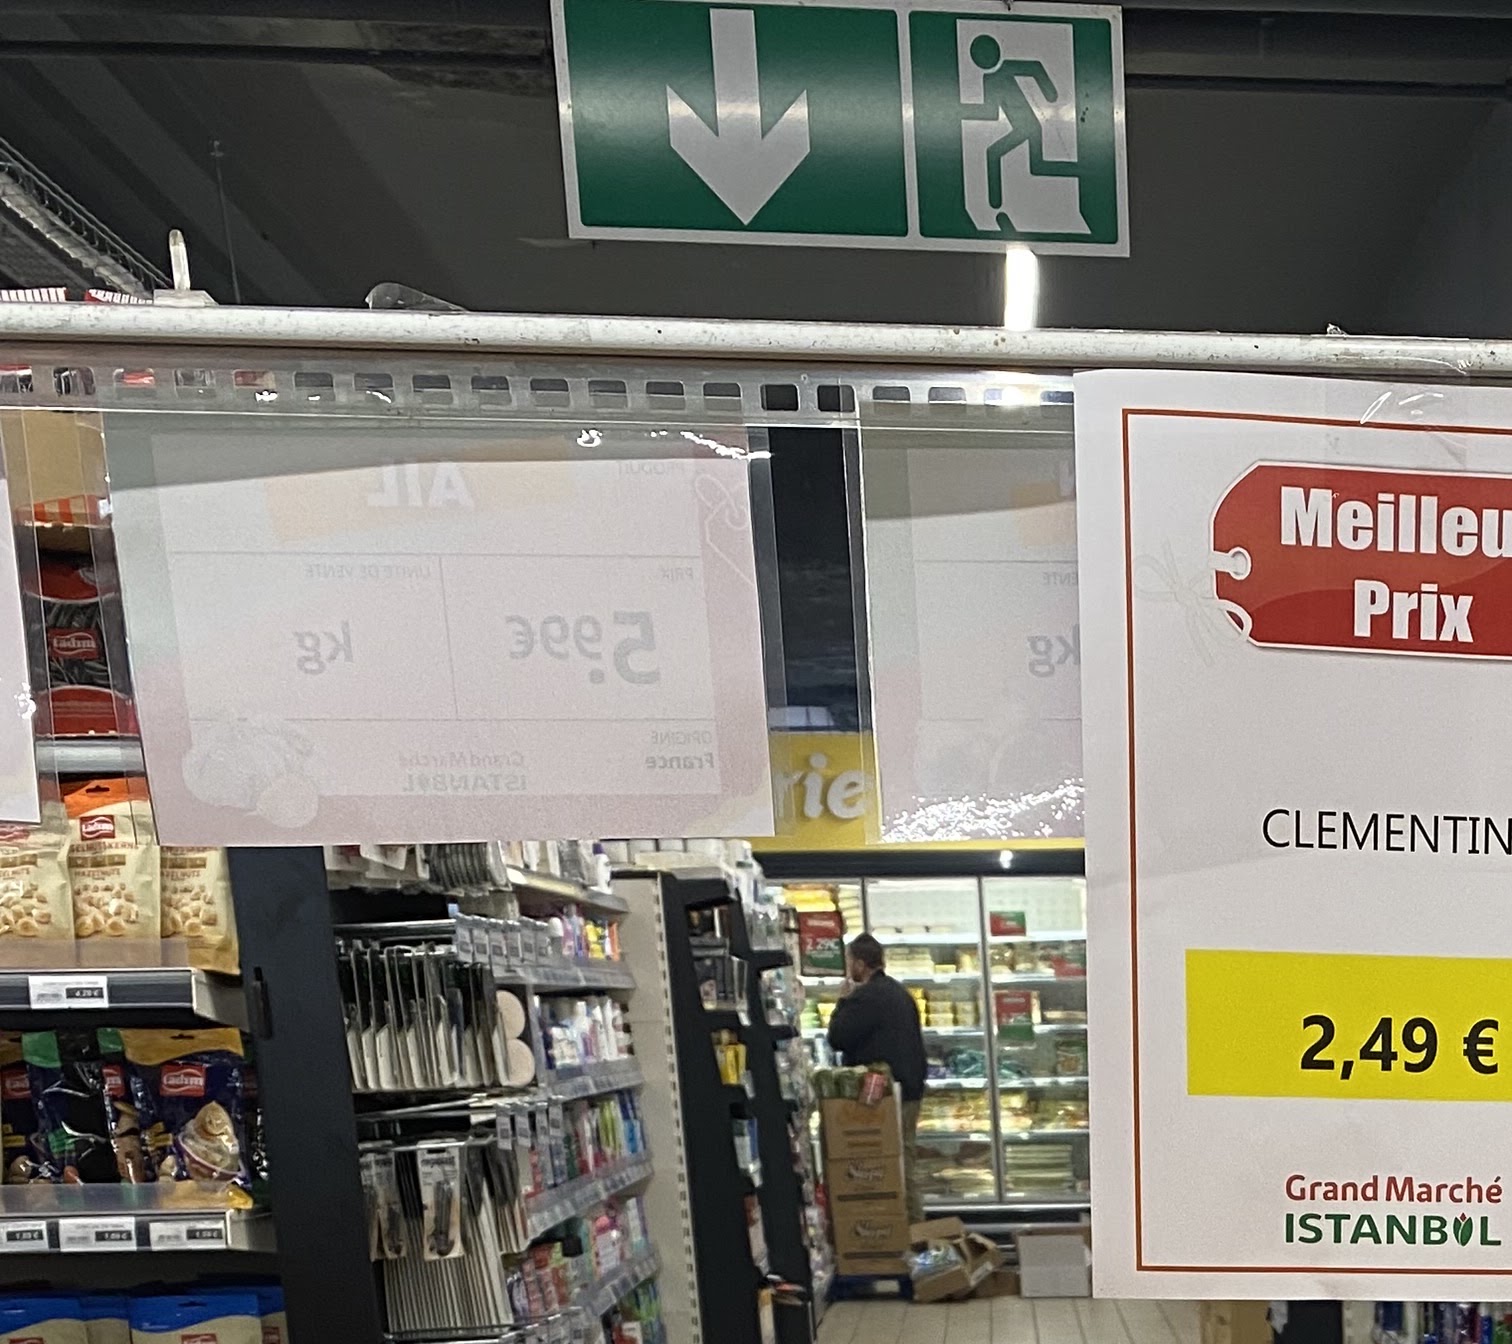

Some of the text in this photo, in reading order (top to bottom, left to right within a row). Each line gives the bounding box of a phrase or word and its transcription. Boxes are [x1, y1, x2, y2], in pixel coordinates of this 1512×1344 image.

[1353, 579, 1474, 643] Prix
[775, 752, 871, 820] rie
[1300, 1014, 1500, 1080] 2,49 €
[1285, 1174, 1503, 1206] Grand Marché
[1285, 1211, 1502, 1248] ISTANBUL
